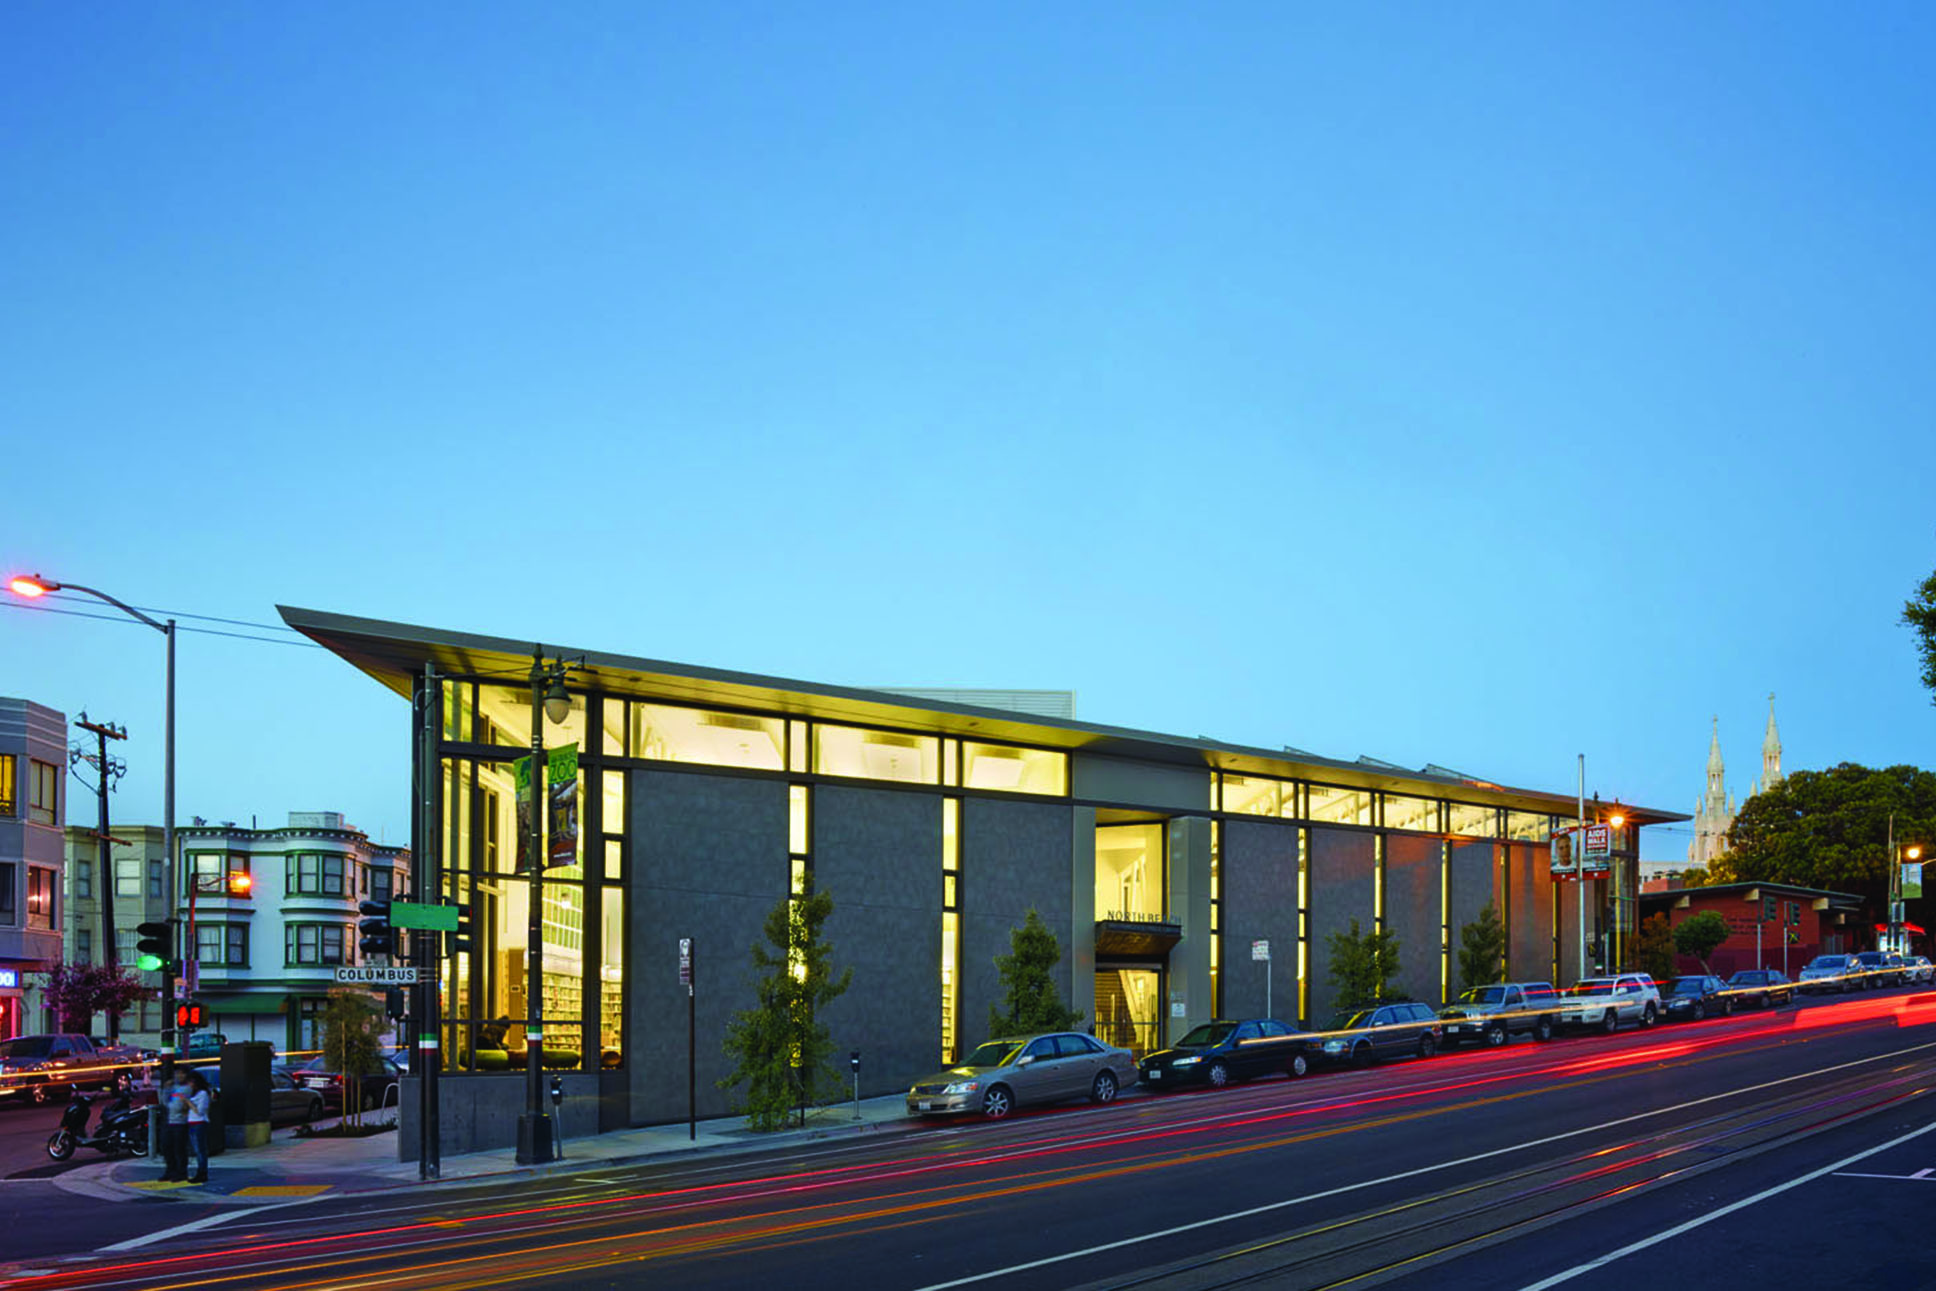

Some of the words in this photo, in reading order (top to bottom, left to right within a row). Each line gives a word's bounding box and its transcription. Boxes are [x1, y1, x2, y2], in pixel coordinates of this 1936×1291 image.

[550, 760, 576, 781] ZOO
[1107, 910, 1145, 922] NORTH
[338, 969, 414, 980] COLUMBUS
